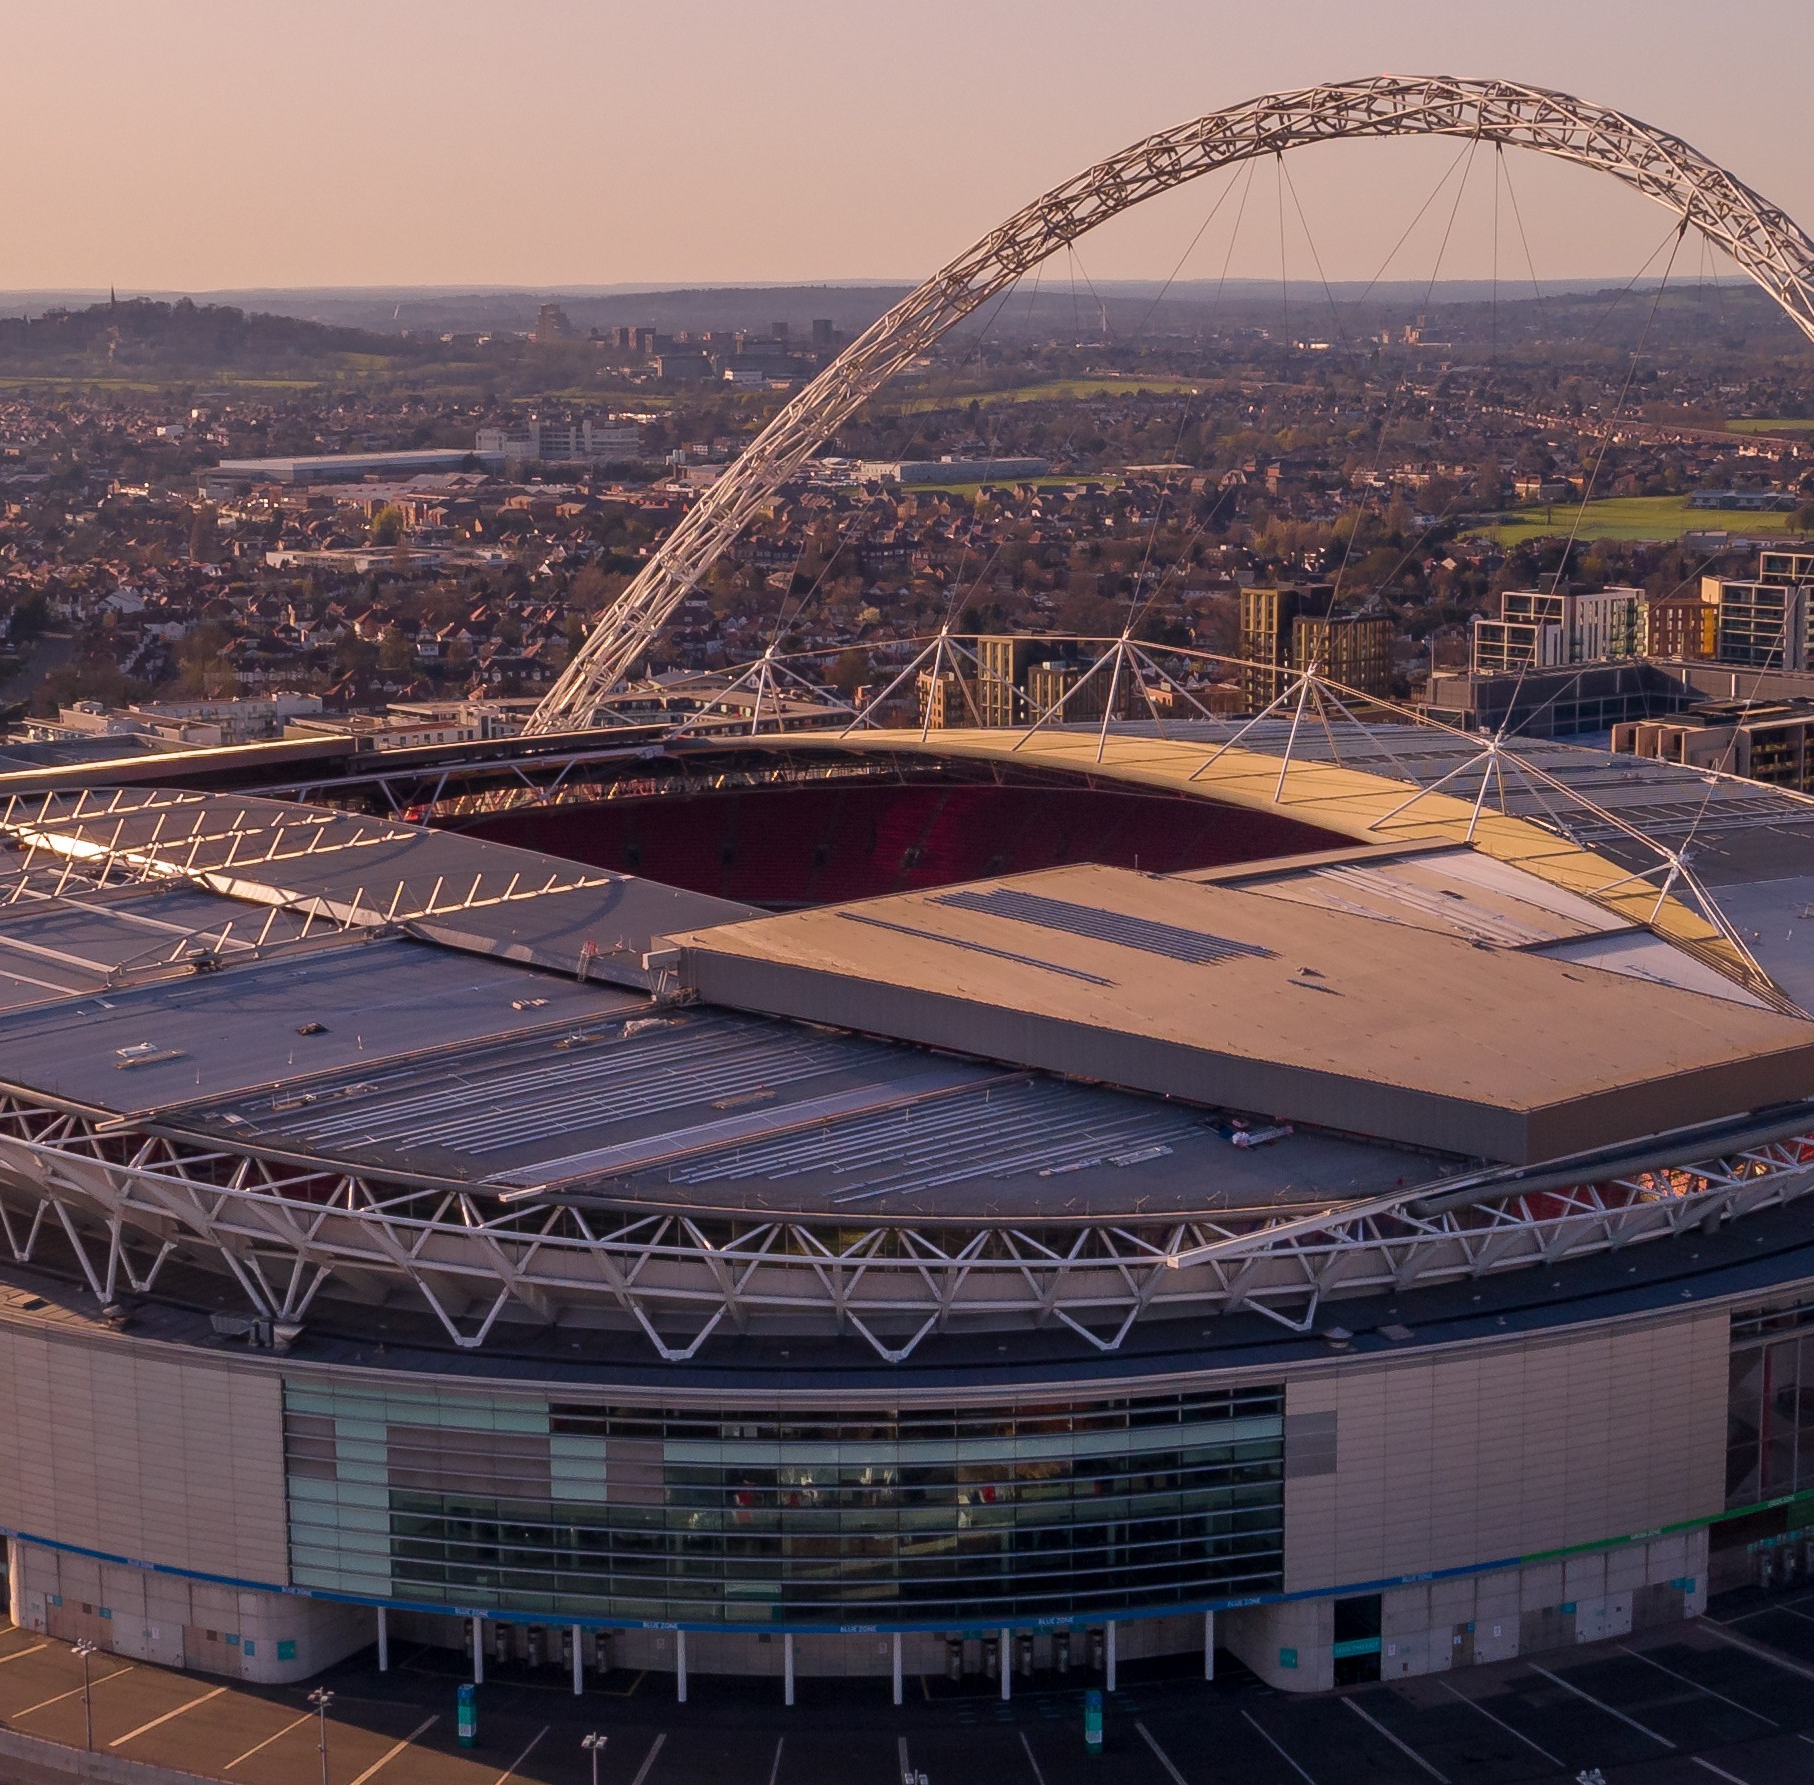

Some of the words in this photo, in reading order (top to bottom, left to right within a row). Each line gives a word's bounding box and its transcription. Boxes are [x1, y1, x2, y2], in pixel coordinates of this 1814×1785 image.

[643, 1620, 658, 1629] BLUE
[659, 1621, 678, 1630] ZONE
[840, 1624, 856, 1633] BLUE
[858, 1624, 876, 1633] ZONE
